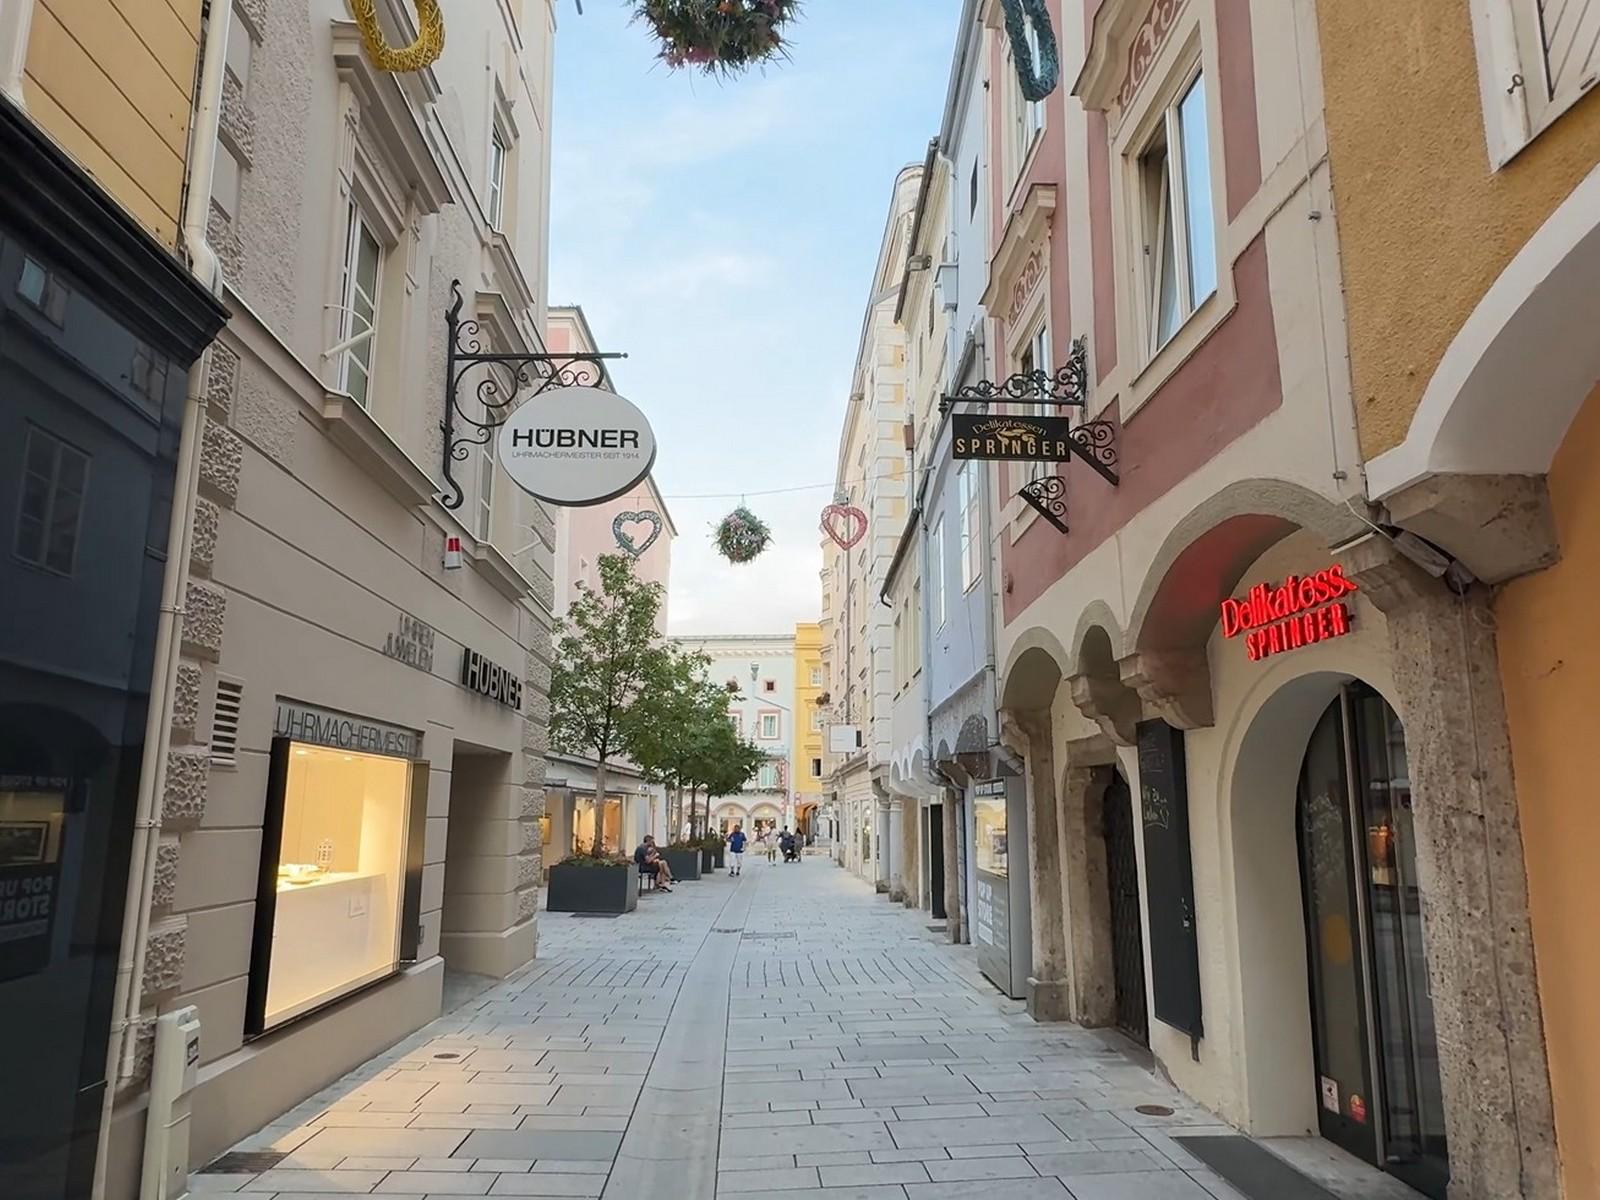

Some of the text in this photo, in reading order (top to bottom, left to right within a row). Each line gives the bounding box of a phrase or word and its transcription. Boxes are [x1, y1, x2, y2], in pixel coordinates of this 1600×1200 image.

[512, 428, 640, 449] HÜBNER
[972, 419, 1048, 437] Delikatessen
[956, 438, 1066, 456] SPRINGER
[1245, 602, 1350, 662] SPRINGER
[275, 705, 424, 757] UHRMACHERMEIST
